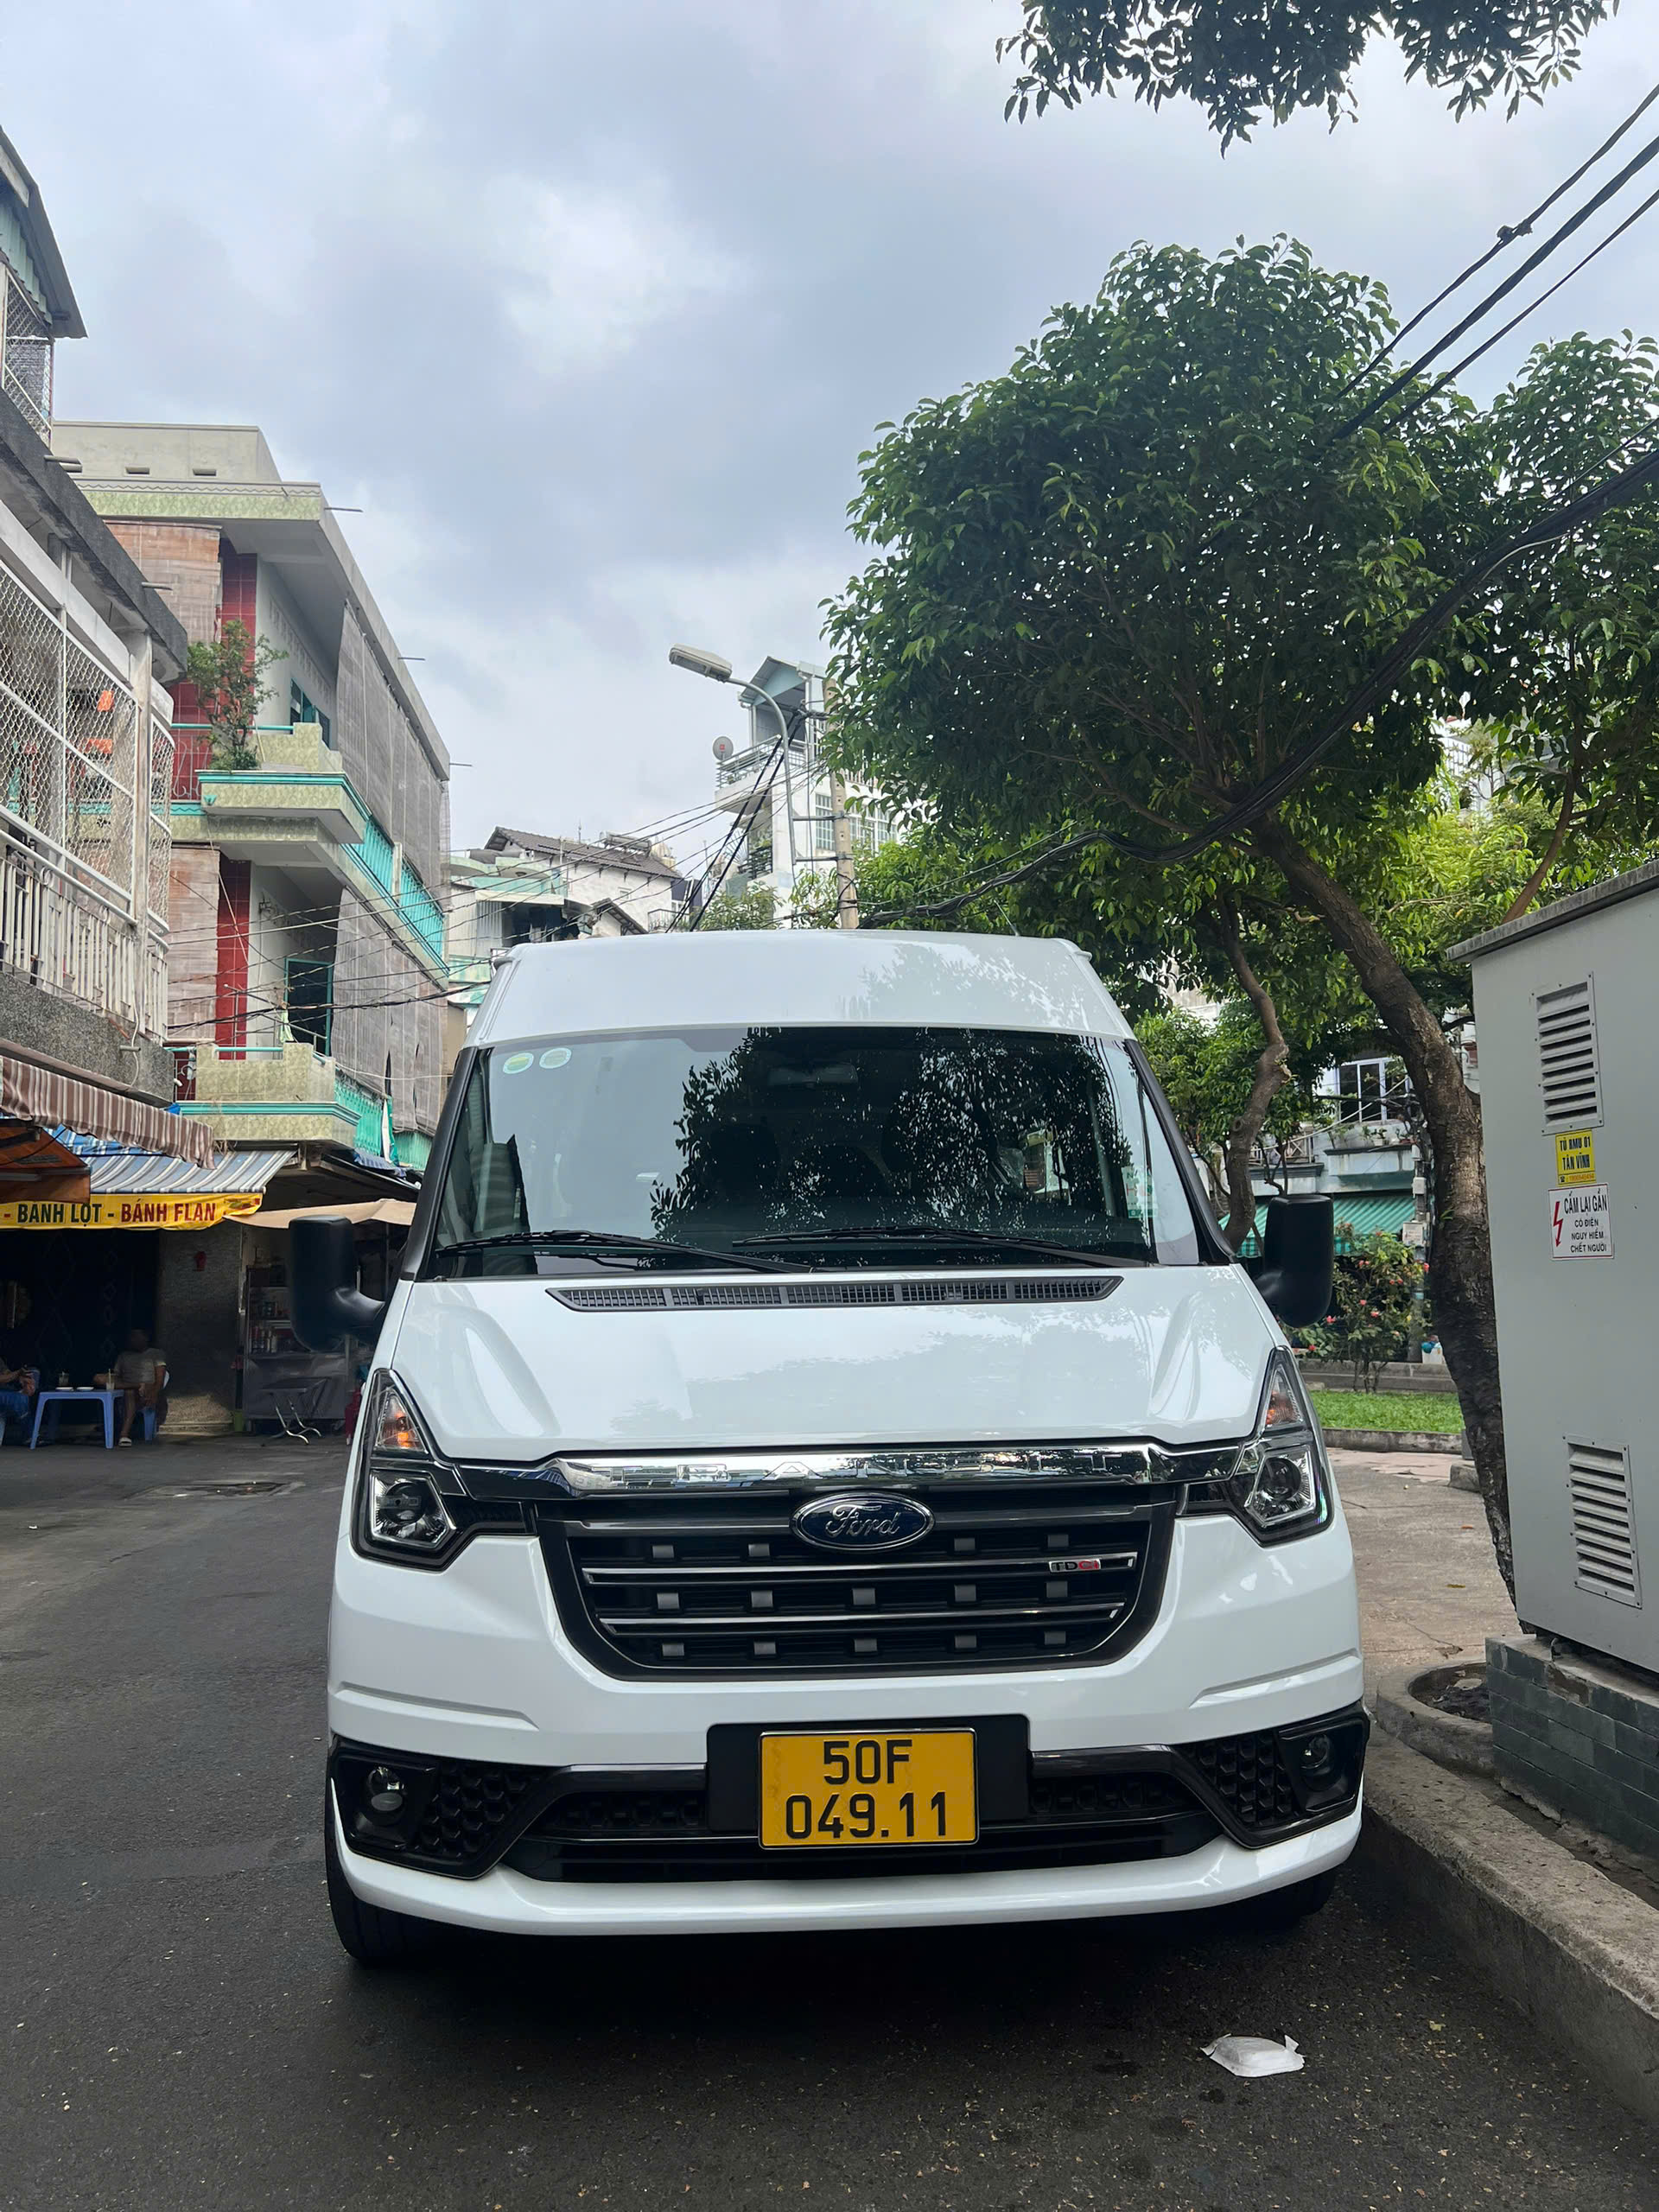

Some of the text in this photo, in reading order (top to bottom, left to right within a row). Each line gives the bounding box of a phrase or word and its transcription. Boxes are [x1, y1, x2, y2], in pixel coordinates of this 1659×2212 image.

[121, 1198, 168, 1223] BÁNH
[174, 1203, 216, 1222] FLAN
[825, 1504, 901, 1538] Ford
[1052, 1560, 1099, 1572] TDCi
[823, 1738, 912, 1785] 50F
[785, 1790, 946, 1840] 049.11
